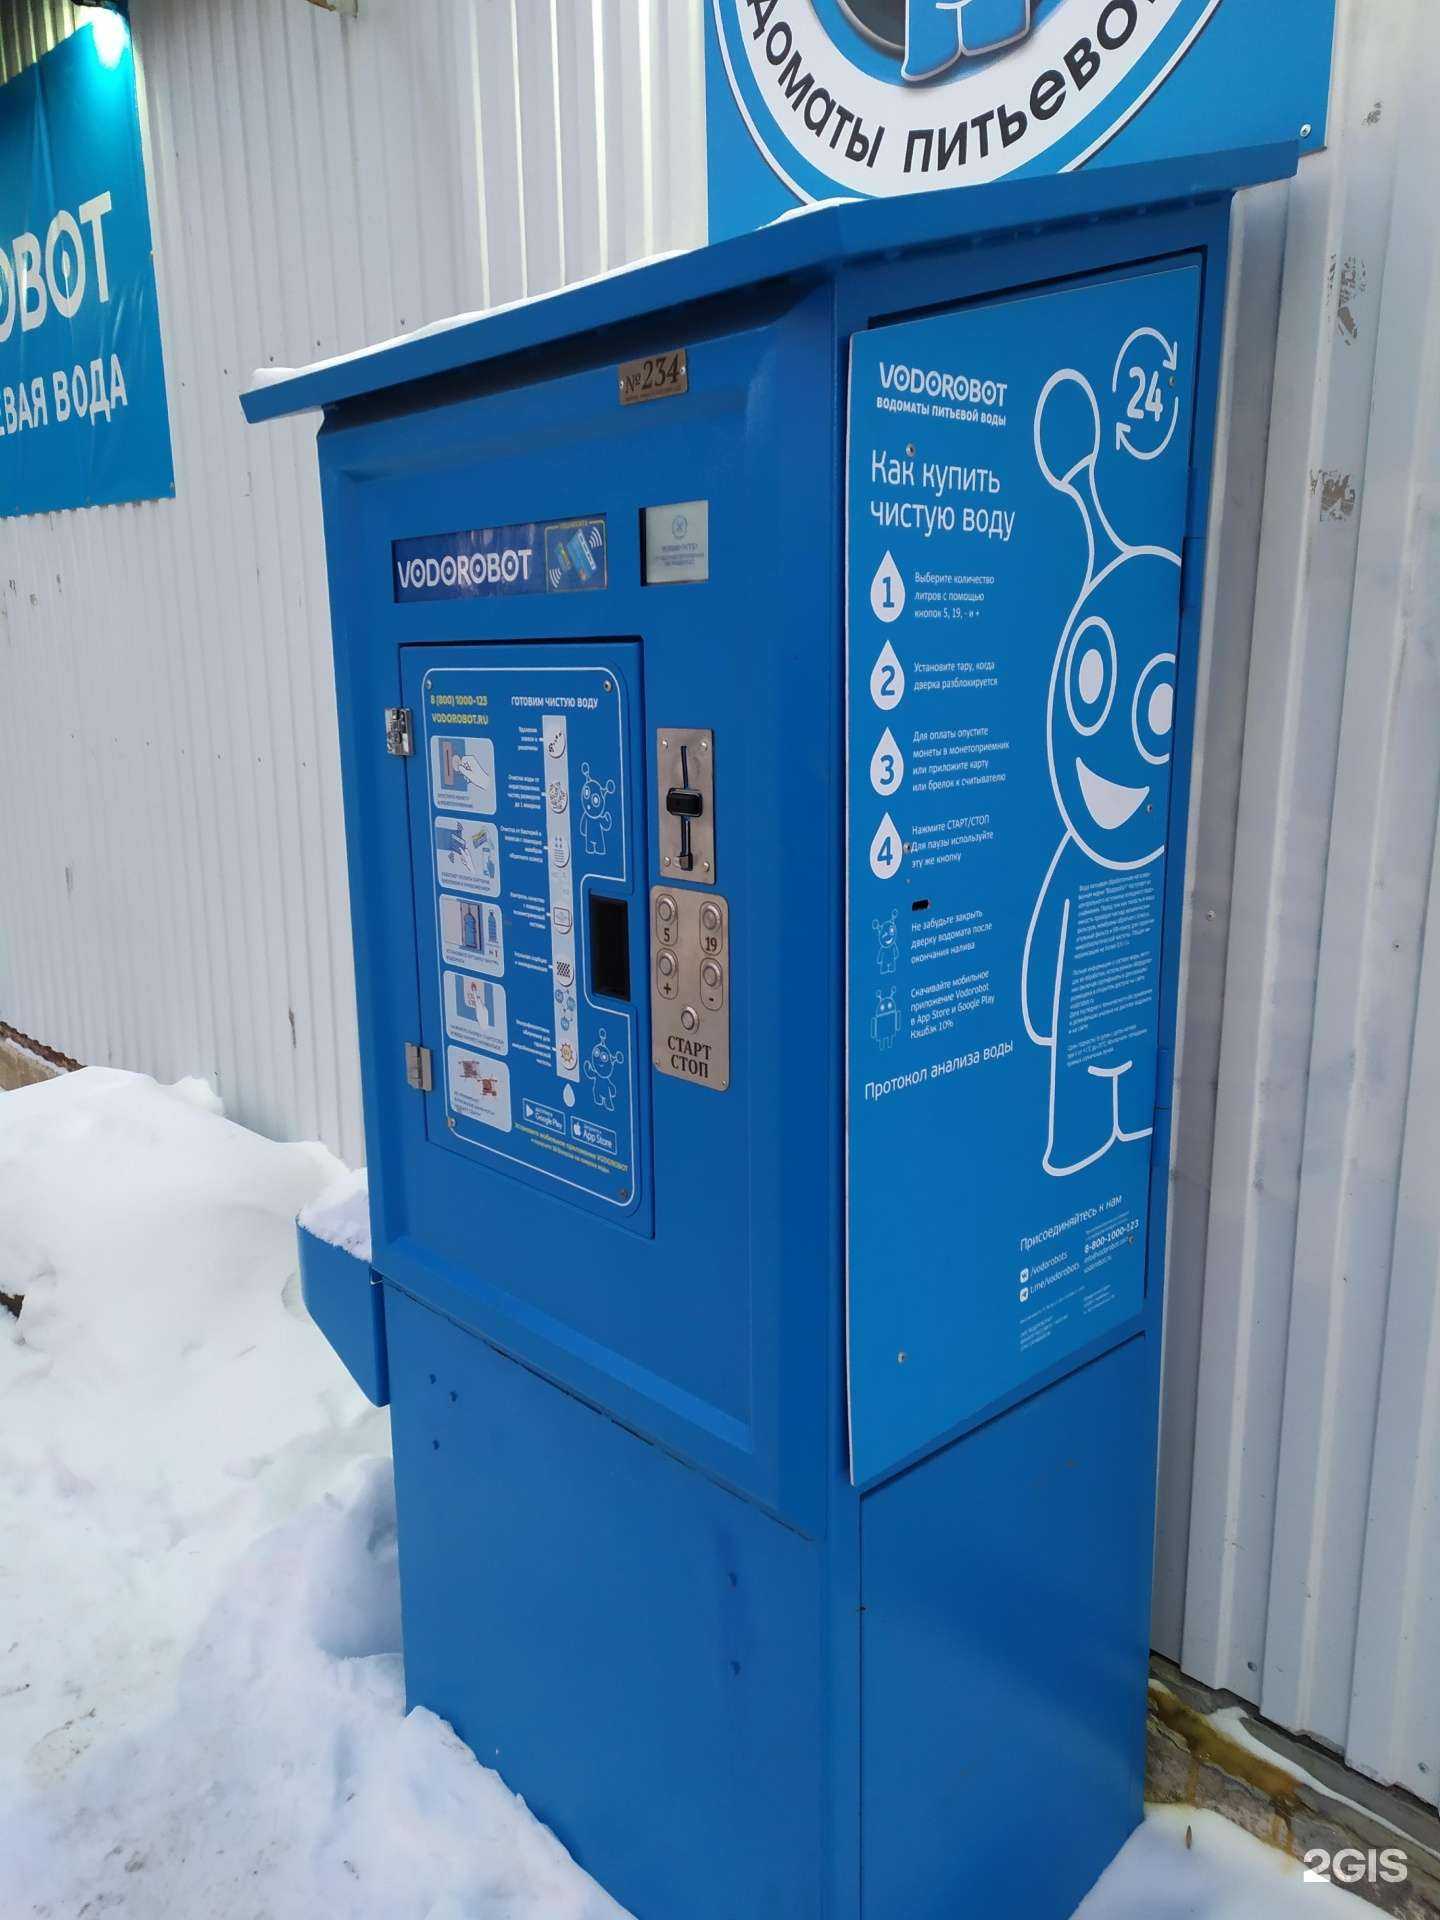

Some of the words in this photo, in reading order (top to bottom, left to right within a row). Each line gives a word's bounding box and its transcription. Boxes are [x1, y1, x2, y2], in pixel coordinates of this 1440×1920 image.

[0, 376, 48, 436] ВАЯ
[53, 353, 128, 426] ВОДА
[879, 361, 1008, 407] VODOROBOT
[1127, 366, 1163, 421] 24
[871, 449, 915, 486] Как
[922, 462, 1000, 498] купить
[870, 500, 955, 538] чистую
[962, 508, 1015, 542] воду
[397, 549, 533, 588] VODOROBOT
[914, 571, 953, 586] Выберите
[954, 574, 995, 585] количество
[882, 576, 895, 609] 1
[914, 592, 942, 602] литров
[948, 593, 985, 602] помощью
[914, 608, 941, 618] кнопок
[914, 661, 955, 673] Установите
[976, 661, 995, 671] когда
[880, 664, 896, 697] 2
[914, 680, 941, 691] дверка
[942, 677, 998, 691] разблокируется
[511, 696, 545, 707] ГОТОВИМ
[546, 696, 576, 708] ЧИСТУЮ
[577, 697, 599, 710] ВОДУ
[431, 713, 489, 725] VODOROBOT.RU
[913, 731, 928, 743] Для
[930, 730, 956, 740] оплаты
[958, 727, 989, 740] опустите
[913, 747, 942, 759] монеты
[949, 742, 1010, 756] монетоприемник
[879, 754, 895, 786] 3
[913, 766, 927, 776] или
[928, 761, 968, 774] приложите
[970, 759, 989, 770] карту
[913, 782, 927, 792] или
[928, 778, 954, 791] брелок
[961, 773, 1006, 787] считывателю
[912, 822, 945, 835] Нажмите
[947, 814, 990, 831] СТАРТ/СТОП
[877, 836, 893, 867] 4
[911, 841, 926, 854] Для
[928, 840, 949, 851] паузы
[951, 830, 994, 846] используйте
[912, 857, 923, 869] эту
[924, 855, 935, 866] же
[937, 852, 962, 864] кнопку
[911, 923, 922, 933] Не
[923, 916, 954, 930] забудьте
[955, 910, 983, 922] закрыть
[663, 927, 670, 942] 5
[705, 936, 717, 951] 19
[911, 936, 937, 950] дверку
[938, 927, 971, 942] водомата
[972, 922, 992, 935] после
[911, 949, 949, 964] окончания
[950, 941, 976, 954] налива
[910, 981, 951, 998] Скачивайте
[952, 970, 990, 986] мобильное
[910, 993, 955, 1012] приложение
[955, 983, 990, 1000] Vodorobot
[917, 1014, 930, 1025] App
[932, 1007, 950, 1019] Store
[957, 998, 980, 1013] Google
[667, 1034, 712, 1060] СТАРТ
[671, 1053, 709, 1078] СТОП
[865, 1068, 928, 1101] Протокол
[931, 1051, 980, 1078] анализа
[983, 1040, 1014, 1061] воды
[1020, 1207, 1098, 1252] Присоединяйтесь
[1106, 1195, 1122, 1209] нам
